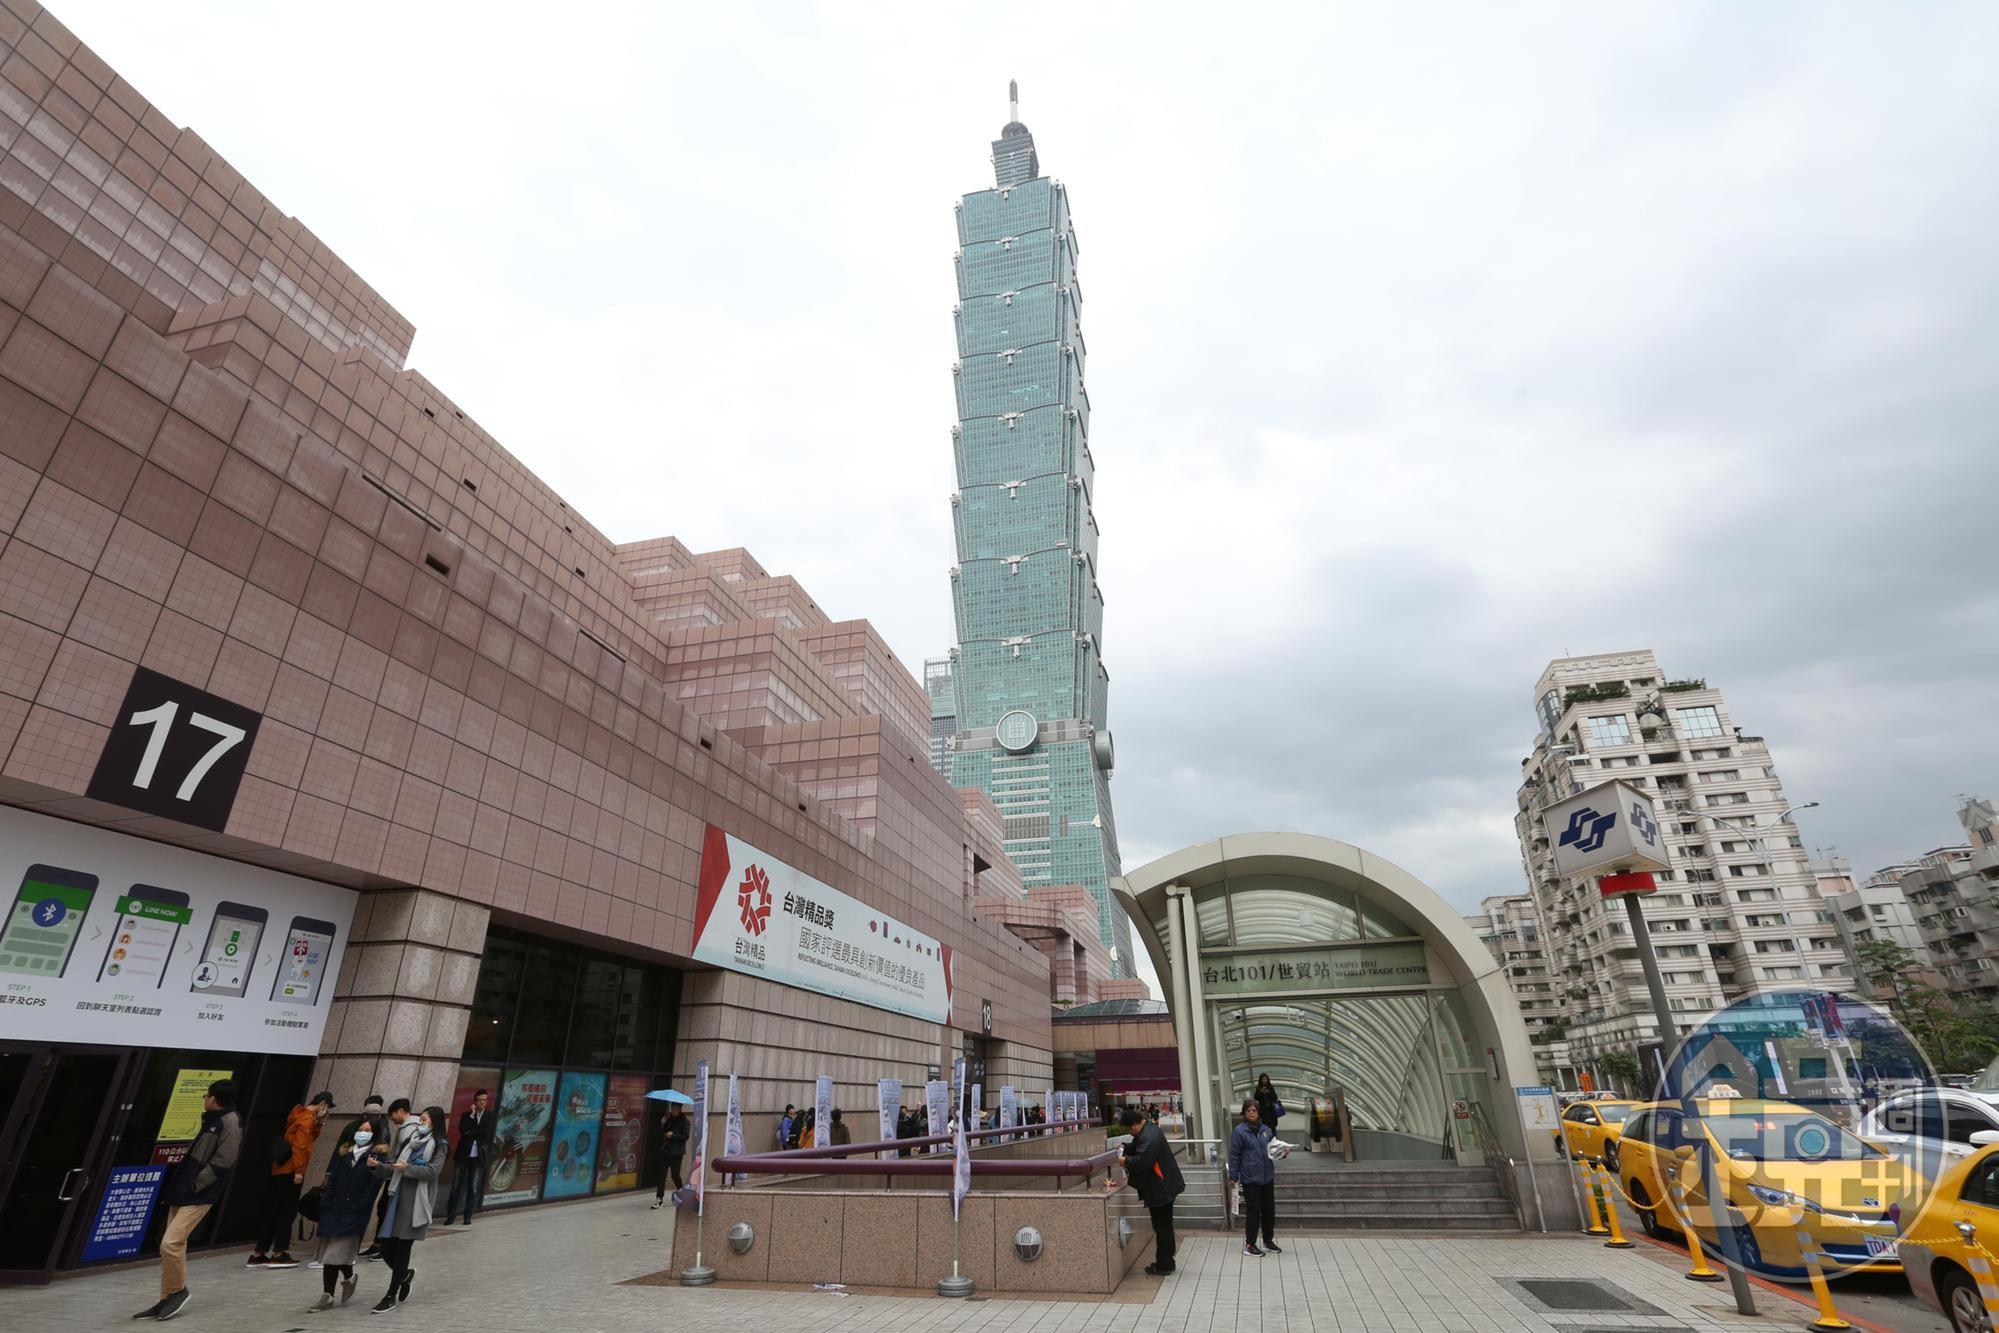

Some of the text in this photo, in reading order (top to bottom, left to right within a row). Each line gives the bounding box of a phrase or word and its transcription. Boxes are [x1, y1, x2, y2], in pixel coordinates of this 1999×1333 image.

[130, 700, 246, 801] 17
[783, 891, 835, 931] 台灣精品獎
[735, 937, 766, 962] 台灣精品
[1203, 961, 1330, 983] 台北101/世貿站
[1335, 961, 1360, 970] TAIPEI
[1335, 968, 1366, 977] WORLD
[1368, 967, 1394, 976] TRADE
[983, 1004, 991, 1030] 18
